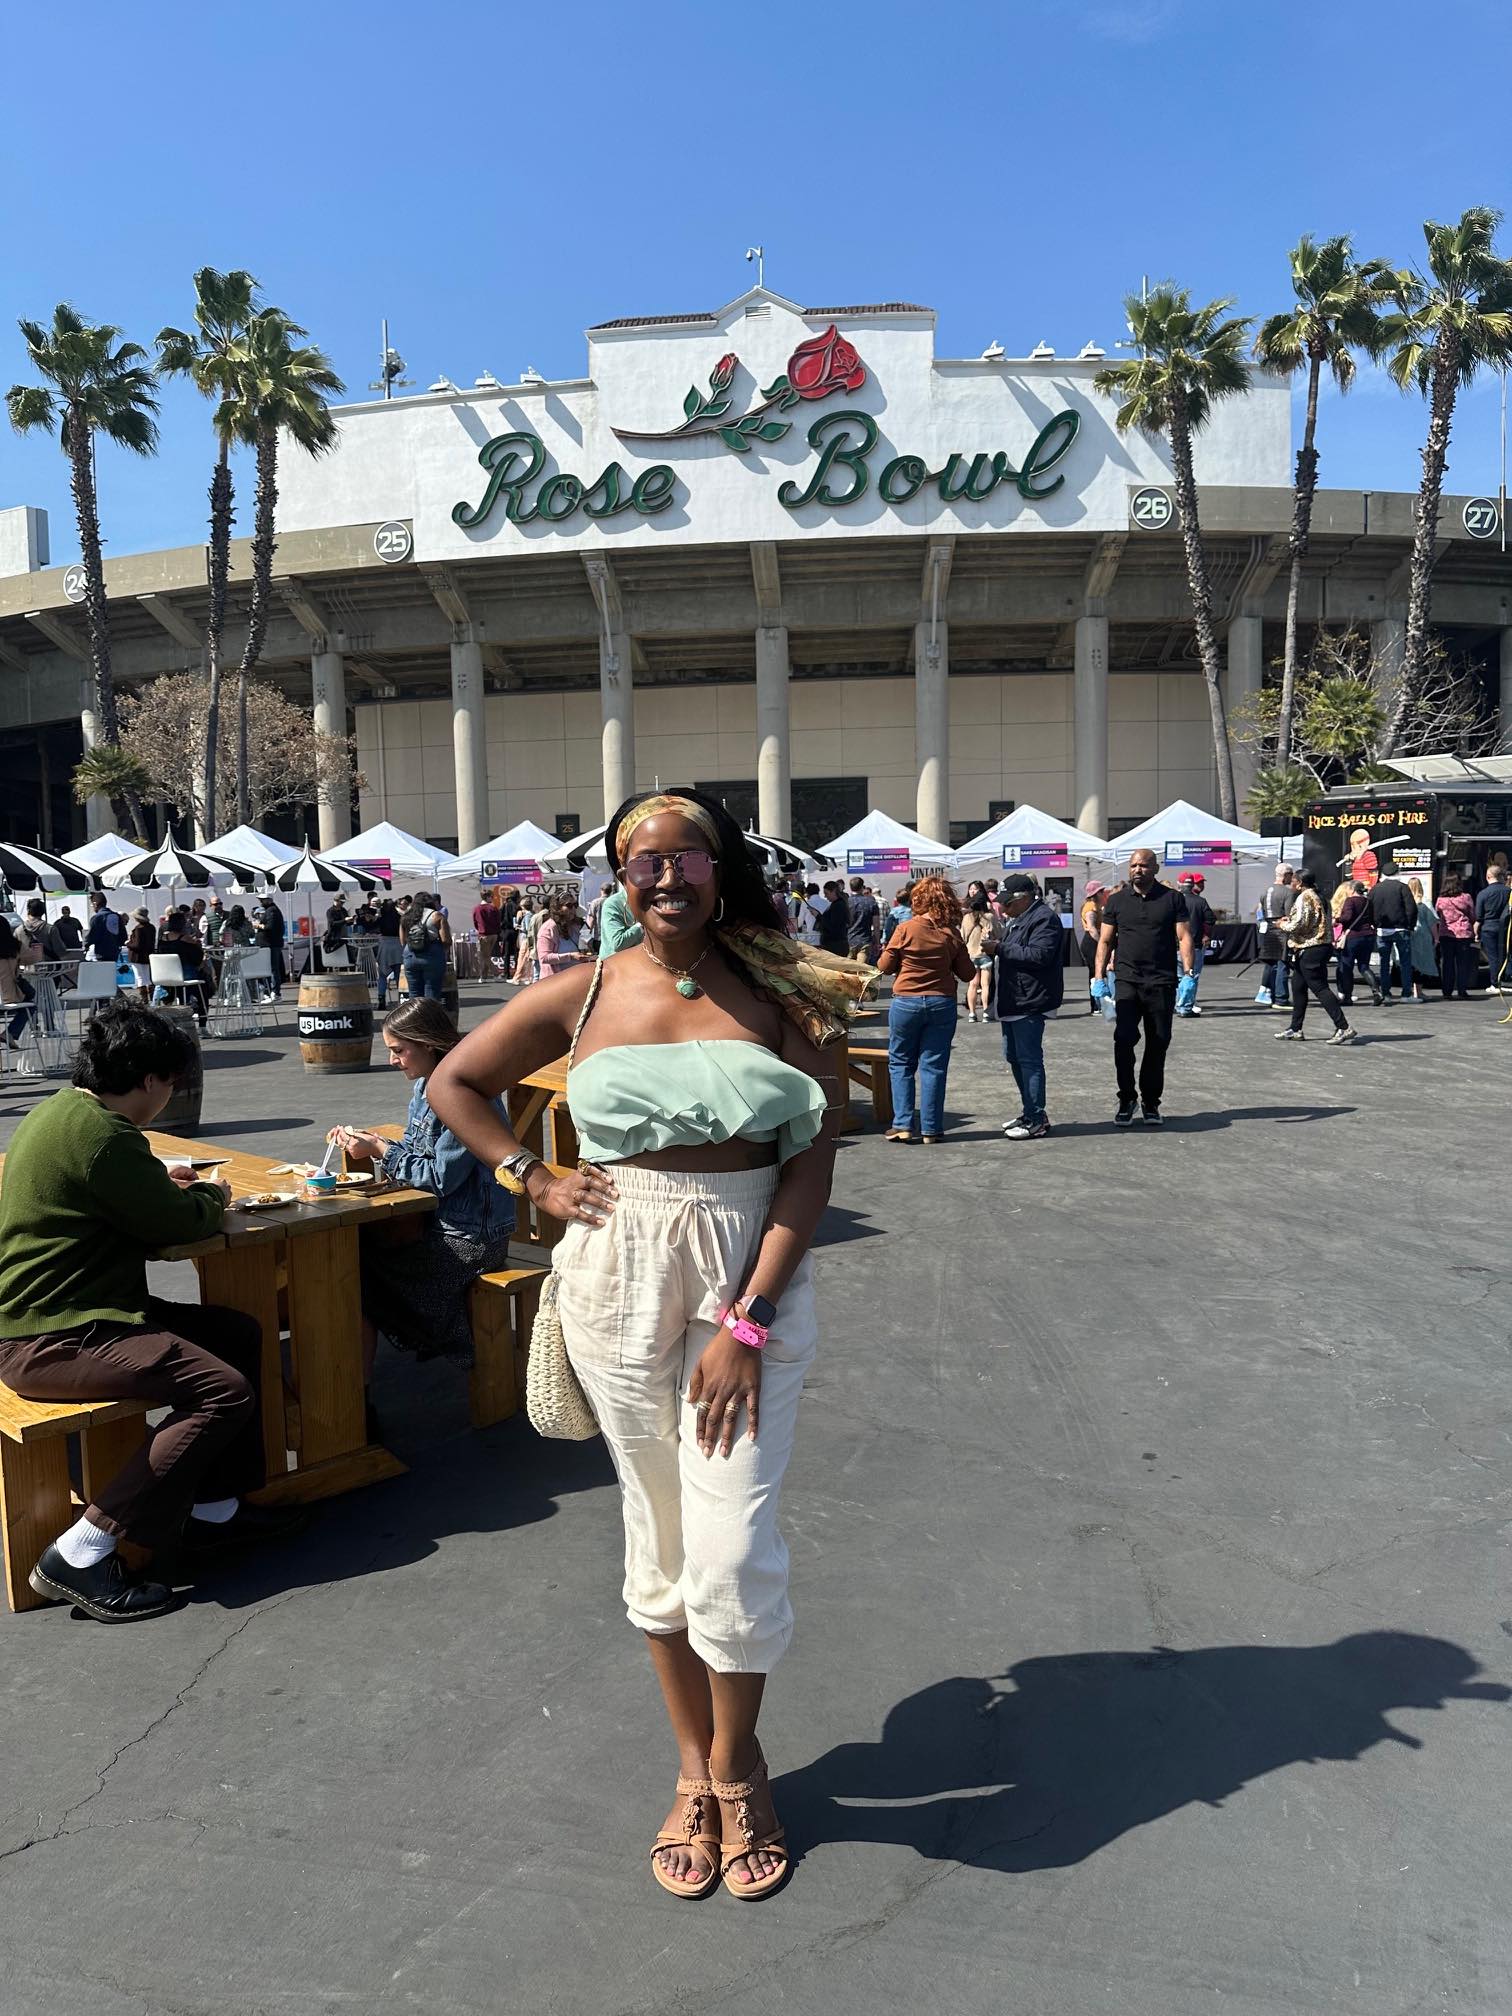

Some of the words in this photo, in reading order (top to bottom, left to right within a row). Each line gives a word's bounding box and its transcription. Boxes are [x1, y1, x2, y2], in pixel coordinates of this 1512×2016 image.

[451, 431, 676, 528] Rose
[777, 409, 1082, 508] Bowl
[1136, 497, 1167, 519] 26
[1467, 507, 1494, 529] 27
[378, 530, 407, 554] 25
[67, 573, 88, 594] 24
[562, 824, 574, 833] 25
[1308, 815, 1336, 829] RICE
[1378, 814, 1395, 824] OF
[1397, 810, 1428, 826] FIRE
[525, 883, 580, 896] OVER
